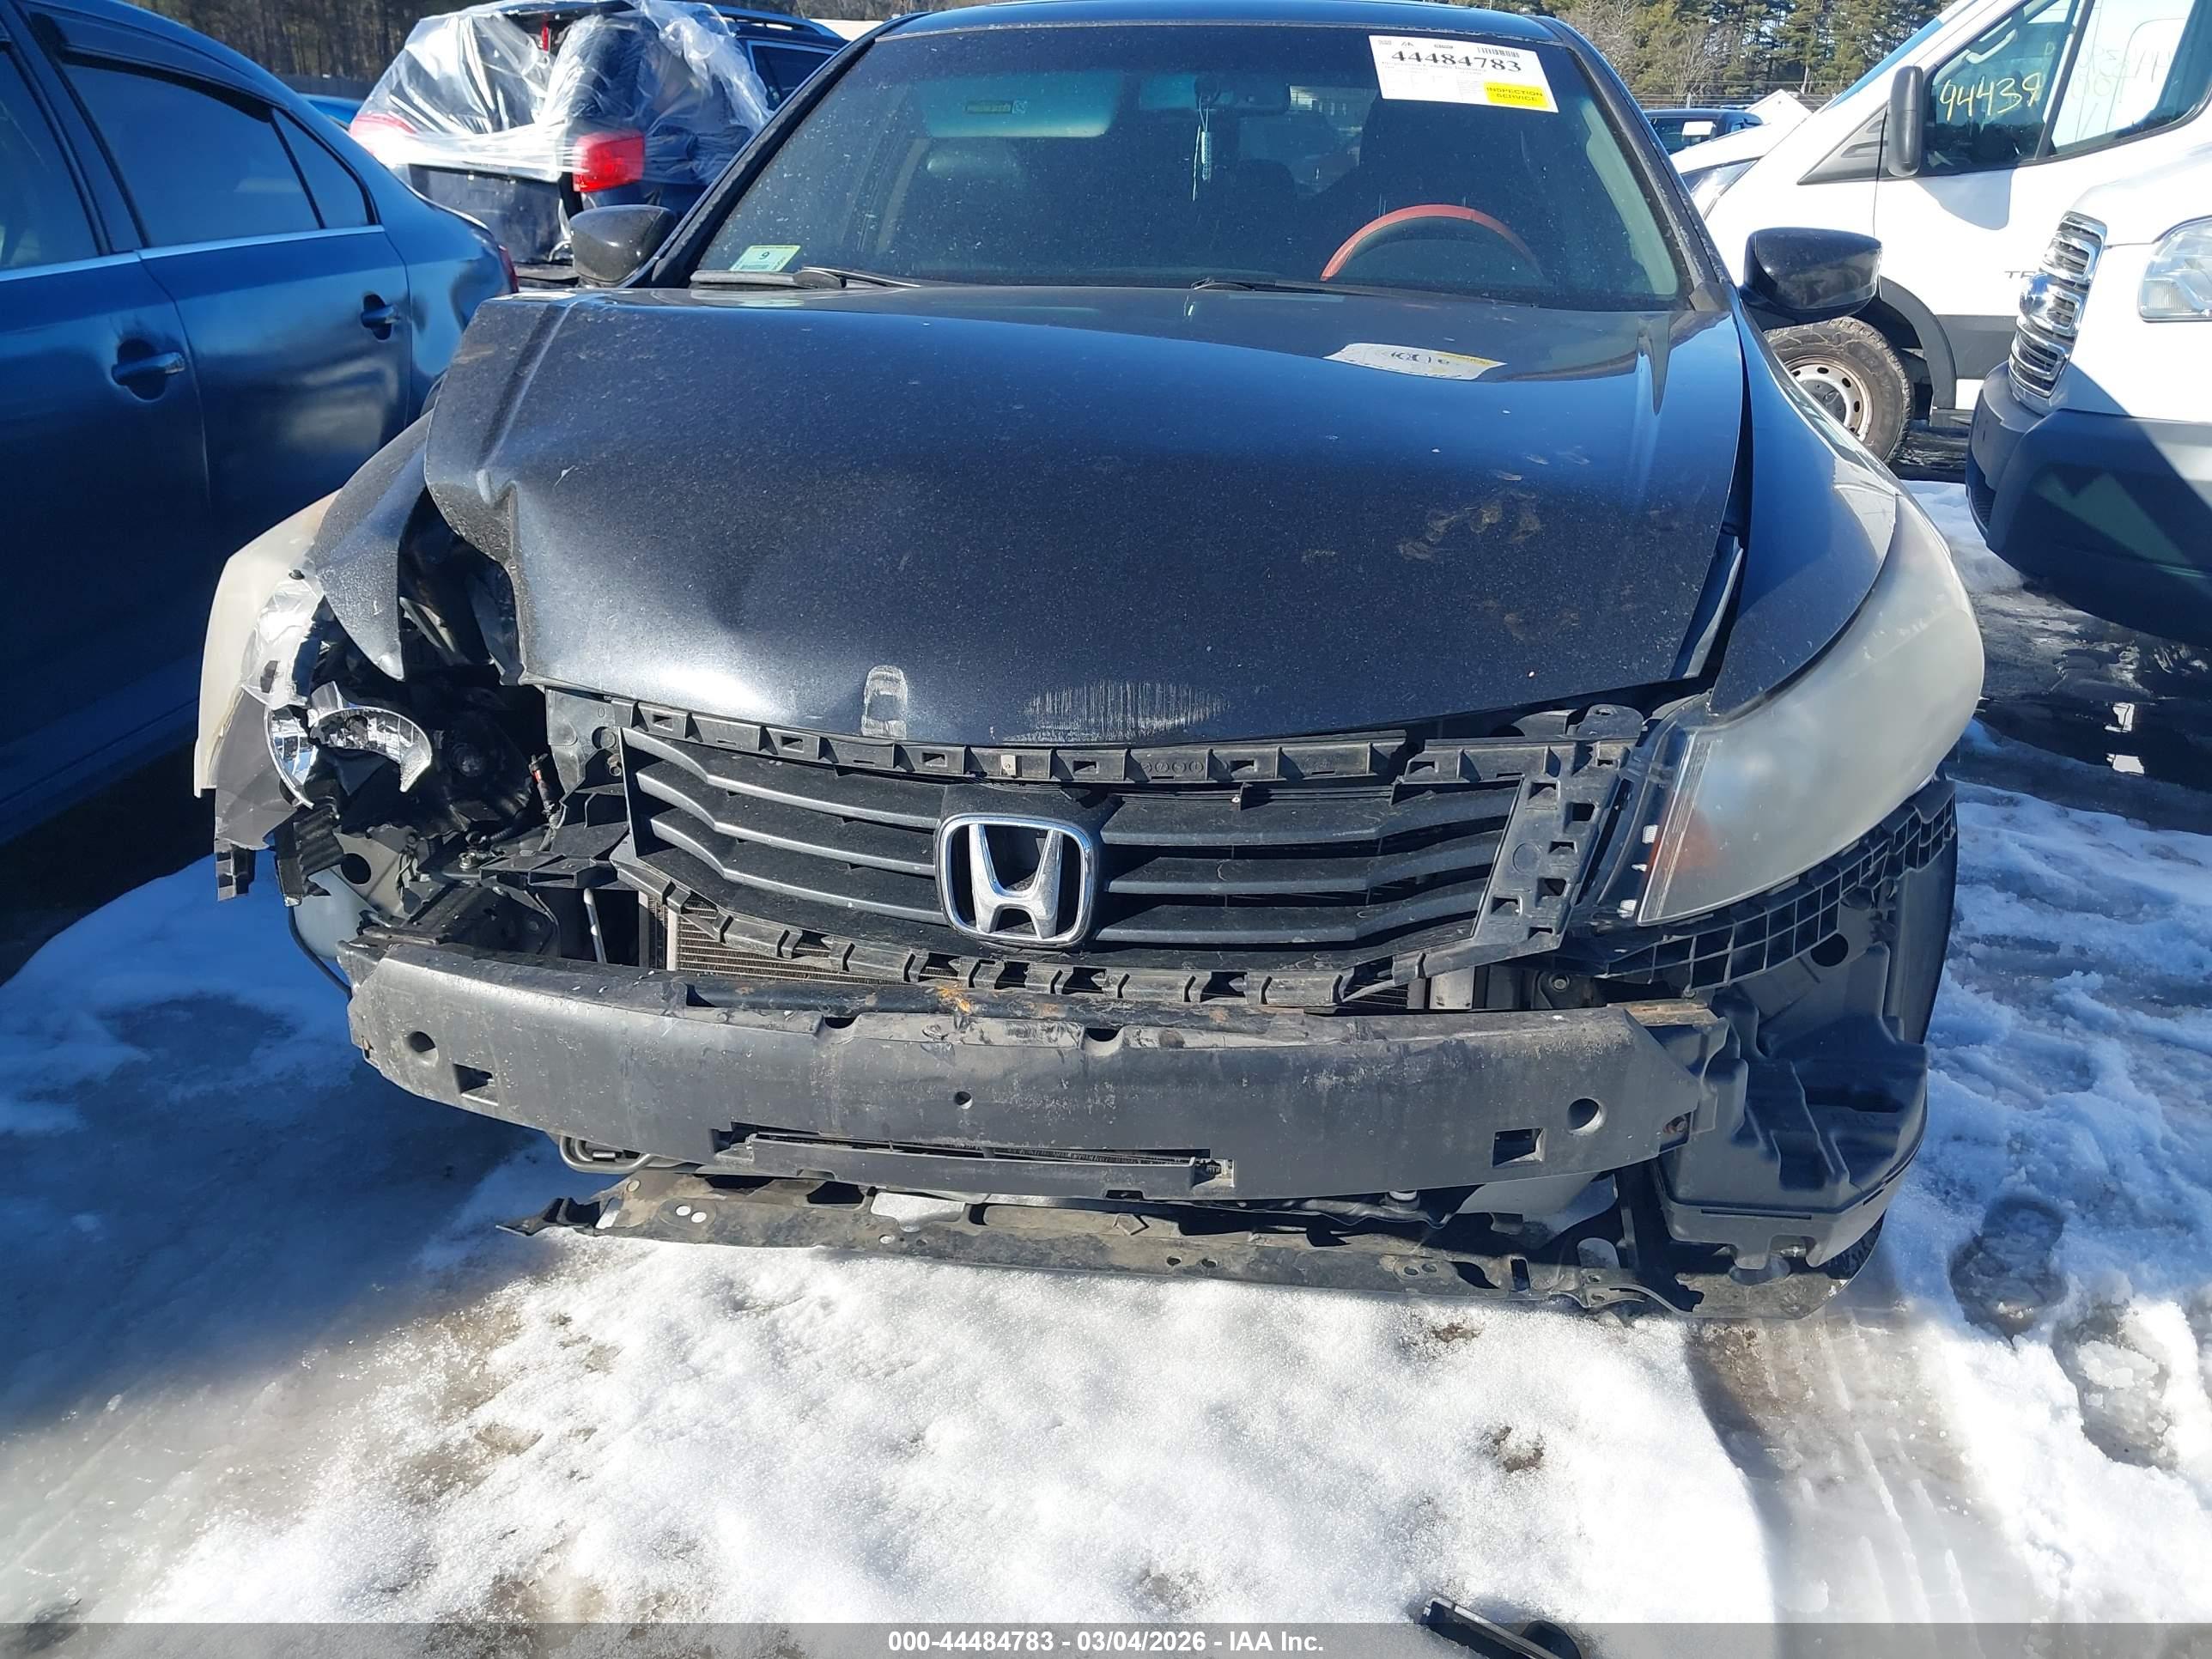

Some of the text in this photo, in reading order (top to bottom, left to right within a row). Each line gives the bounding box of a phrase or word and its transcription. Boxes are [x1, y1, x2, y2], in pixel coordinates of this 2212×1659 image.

[1391, 51, 1522, 72] 44484783
[1486, 87, 1543, 97] INSPECTION
[1496, 93, 1538, 101] SERVICE
[758, 251, 770, 260] 9
